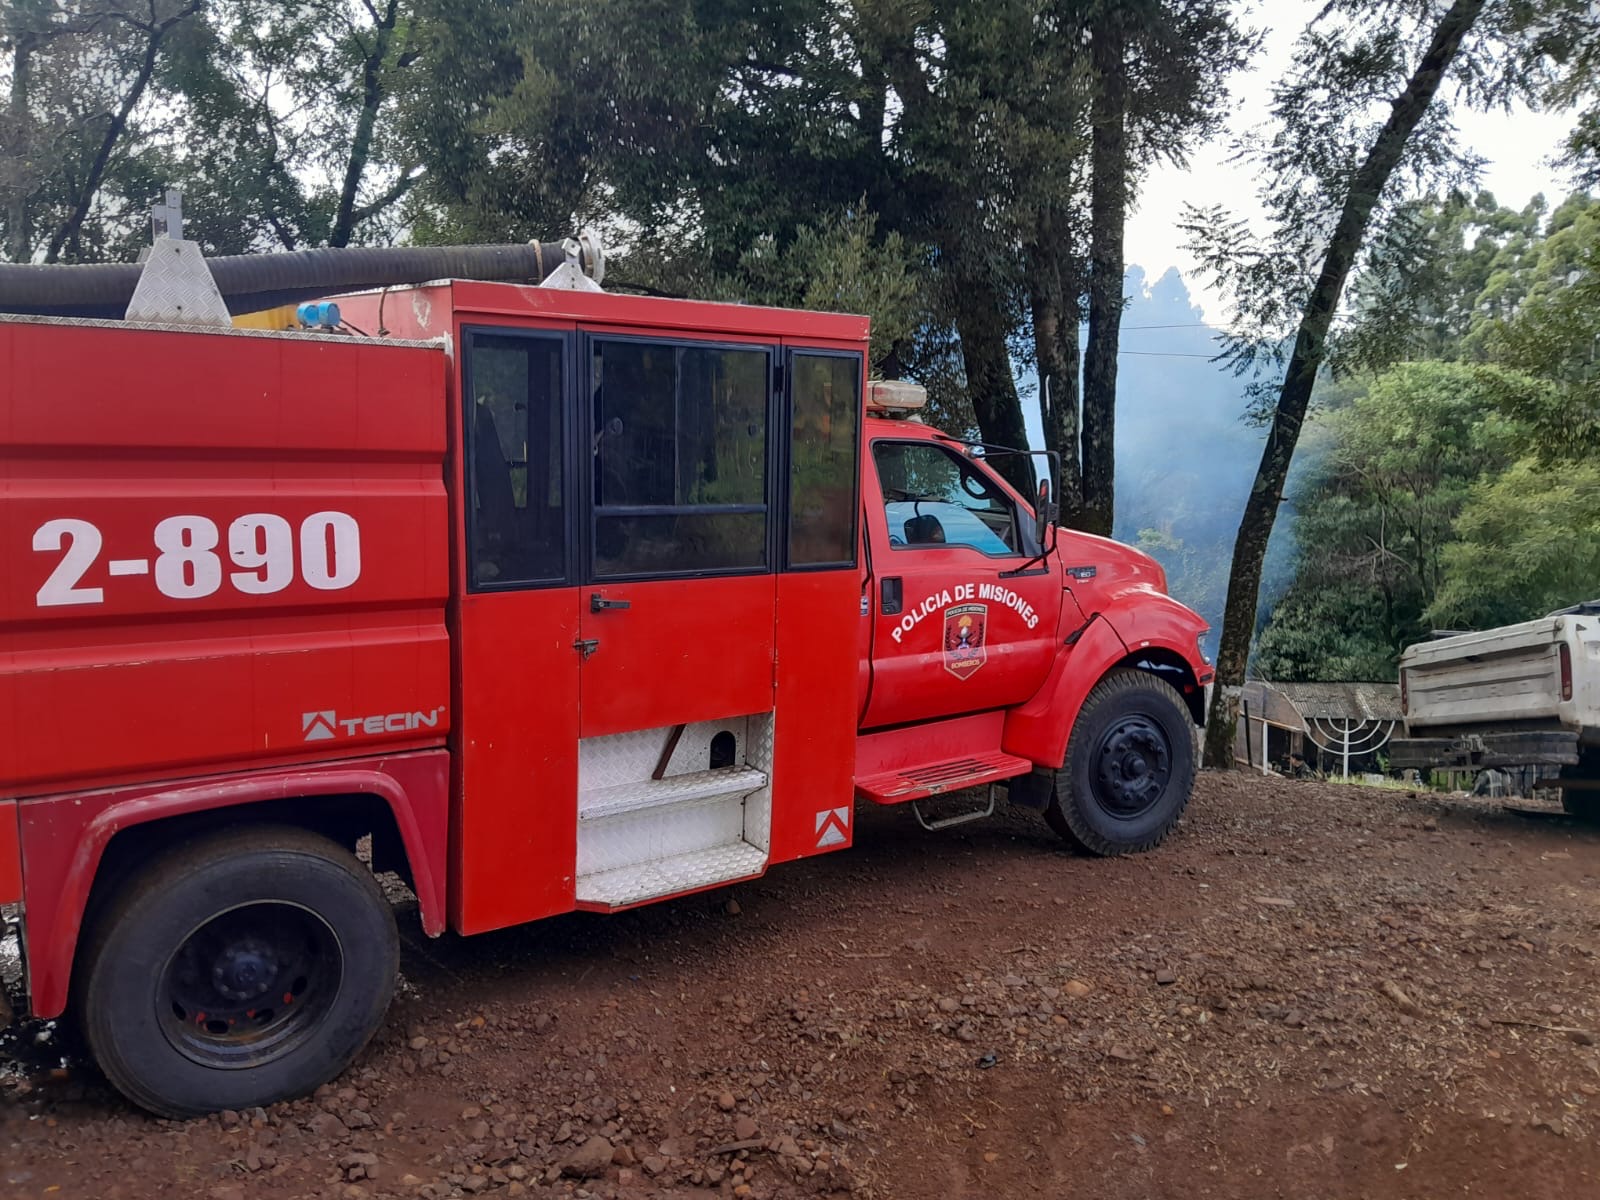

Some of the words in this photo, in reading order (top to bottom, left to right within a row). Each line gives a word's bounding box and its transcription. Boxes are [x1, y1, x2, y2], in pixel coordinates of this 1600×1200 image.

[32, 511, 361, 607] 2-890
[891, 589, 952, 644] POLICIA
[954, 583, 975, 601] DE
[978, 583, 1039, 630] MISIONES
[951, 659, 980, 669] BOMBEROS
